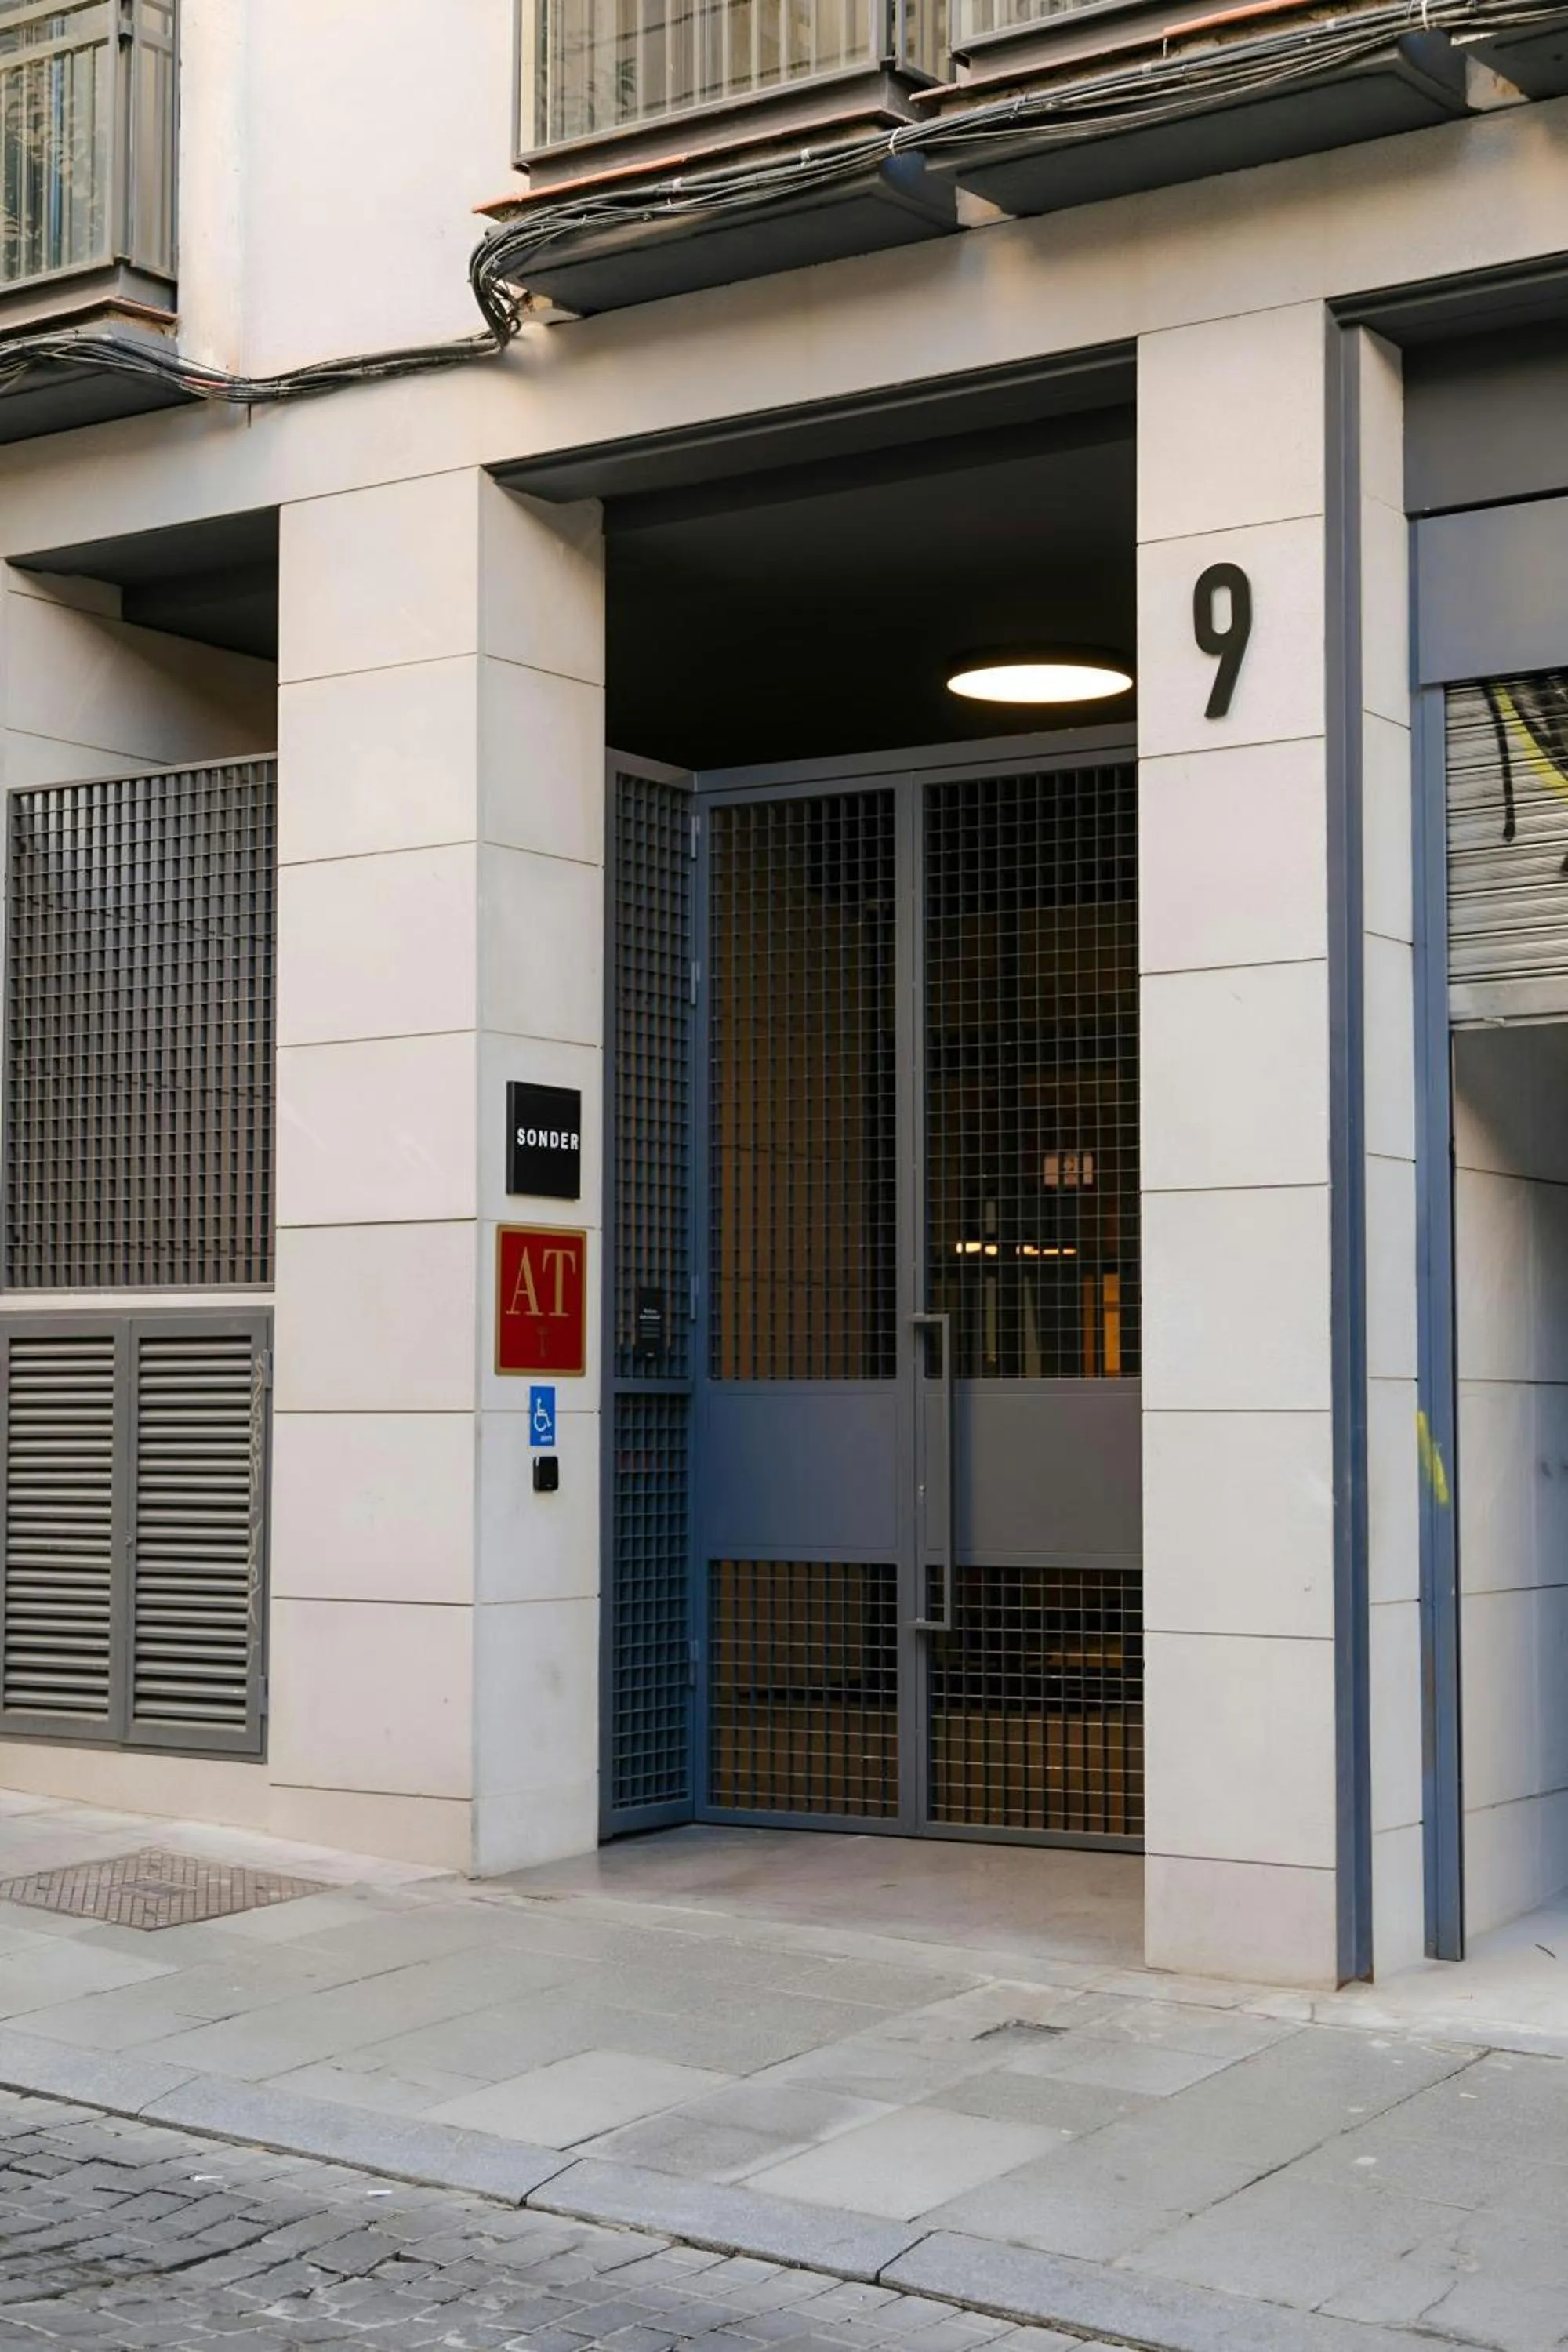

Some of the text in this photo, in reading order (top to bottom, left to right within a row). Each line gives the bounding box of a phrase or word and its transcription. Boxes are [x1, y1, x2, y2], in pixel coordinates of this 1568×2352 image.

[1193, 563, 1252, 719] 9
[517, 1127, 579, 1150] SONDER
[506, 1247, 576, 1316] AT
